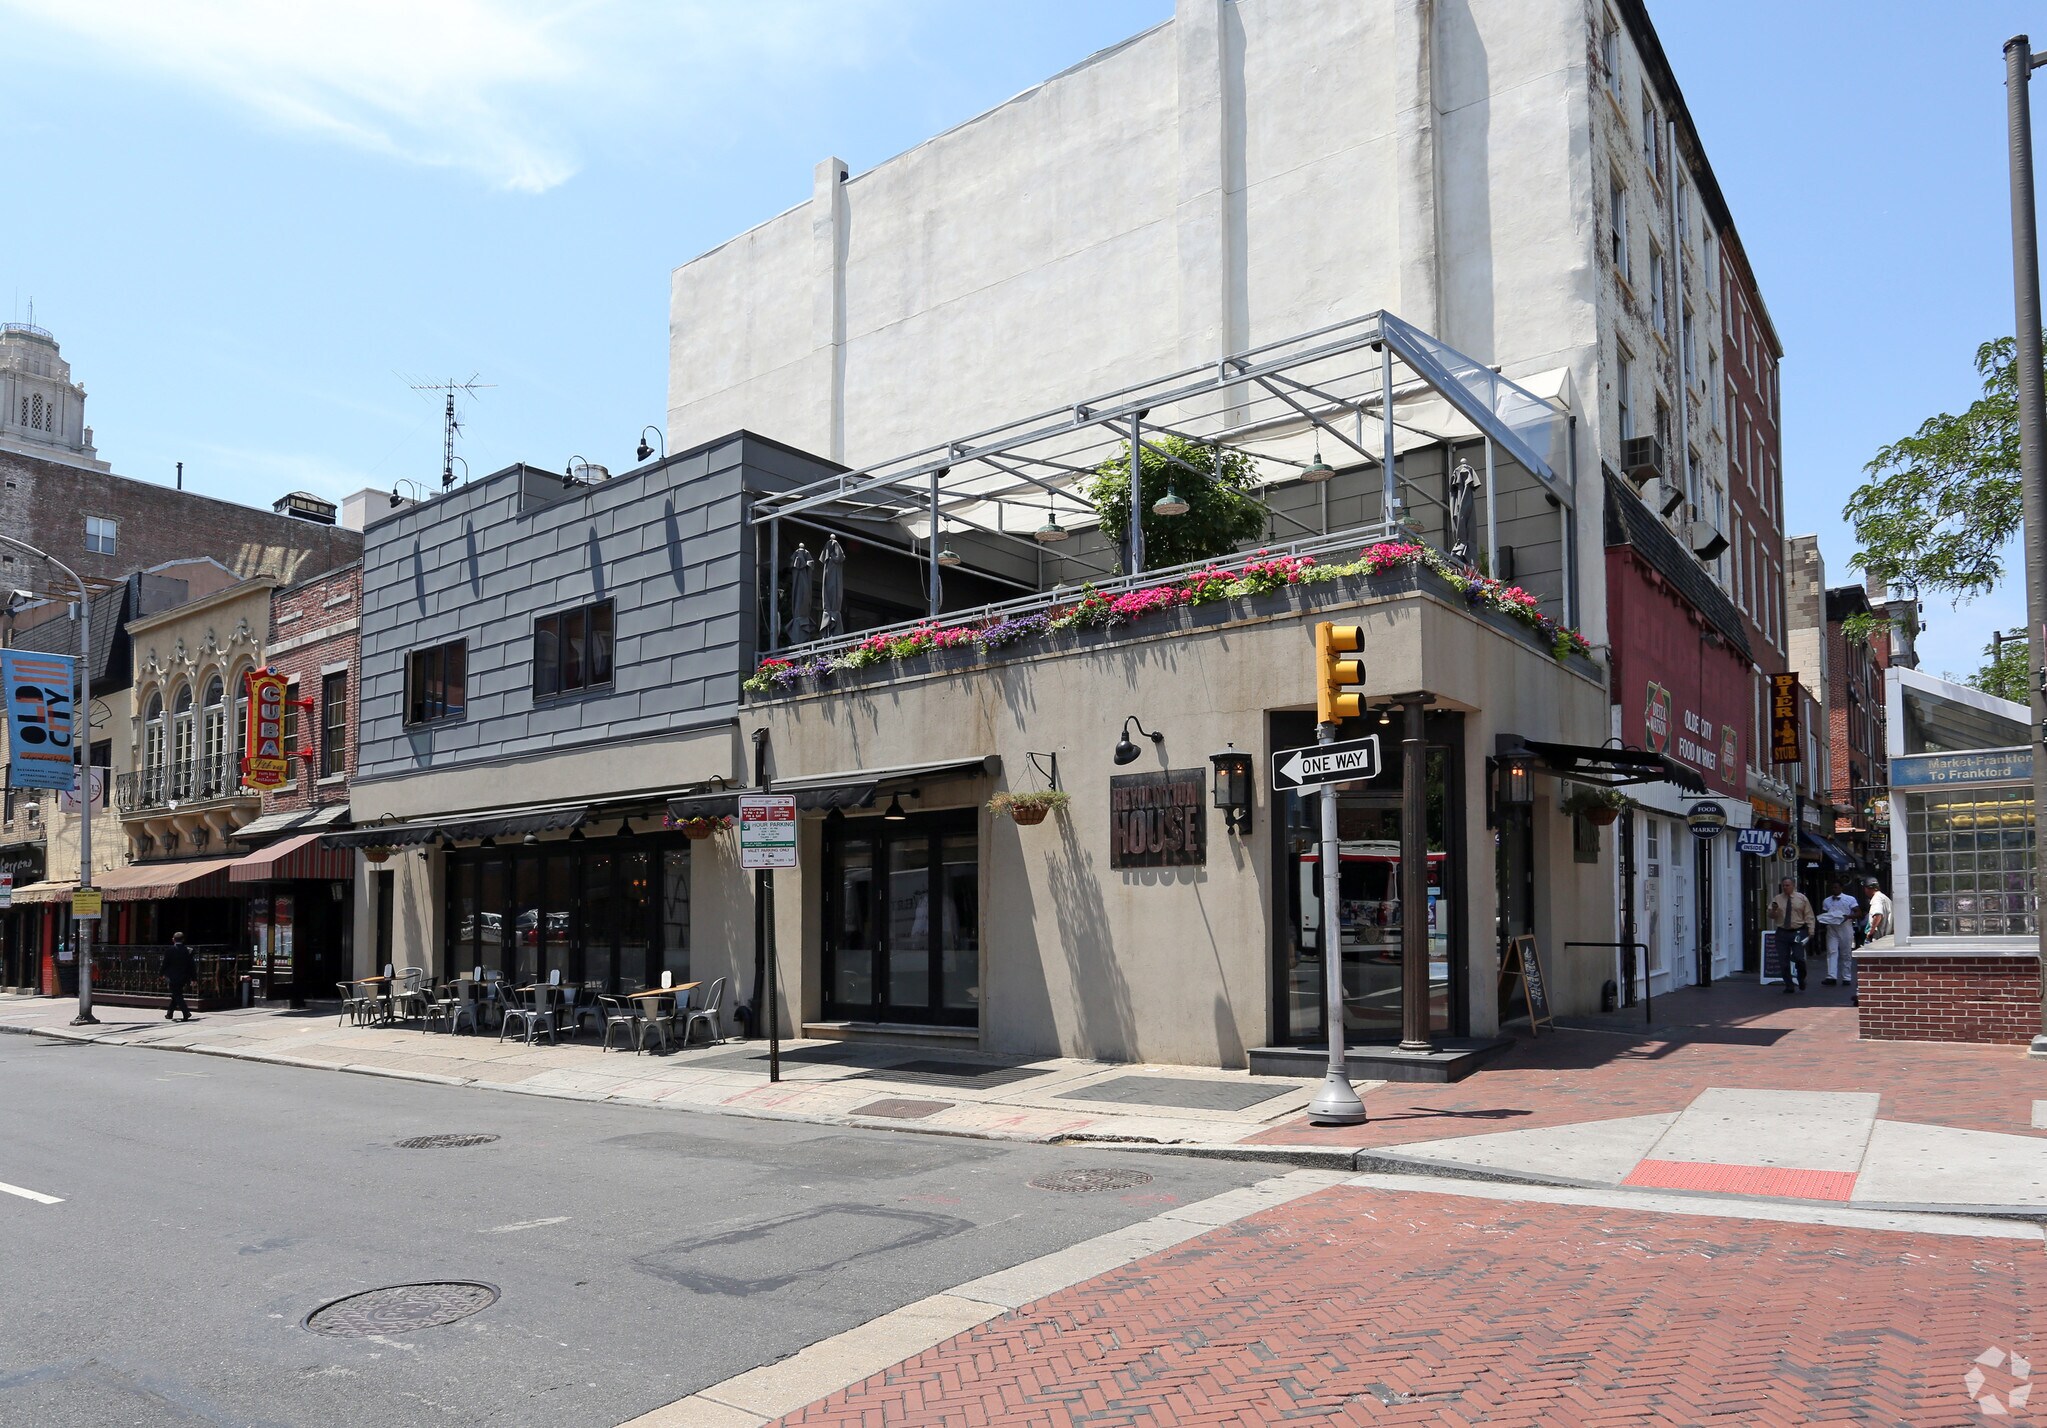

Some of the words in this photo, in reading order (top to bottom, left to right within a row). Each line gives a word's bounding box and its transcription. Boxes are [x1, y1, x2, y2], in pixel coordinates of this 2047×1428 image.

[1775, 676, 1794, 717] BIER
[15, 685, 47, 744] OLD
[44, 687, 70, 747] CITY
[260, 686, 280, 755] CUBA
[1684, 709, 1699, 735] OLDE
[1700, 718, 1713, 741] CITY
[1302, 757, 1330, 774] ONE
[1336, 751, 1363, 769] WAY
[1679, 737, 1695, 761] FOOD
[1696, 745, 1716, 771] MARKET
[1774, 746, 1797, 760] STUBE
[1929, 771, 1945, 781] To
[1949, 767, 2011, 779] Frankford
[1111, 806, 1198, 855] HOUSE
[1738, 829, 1771, 844] ATM
